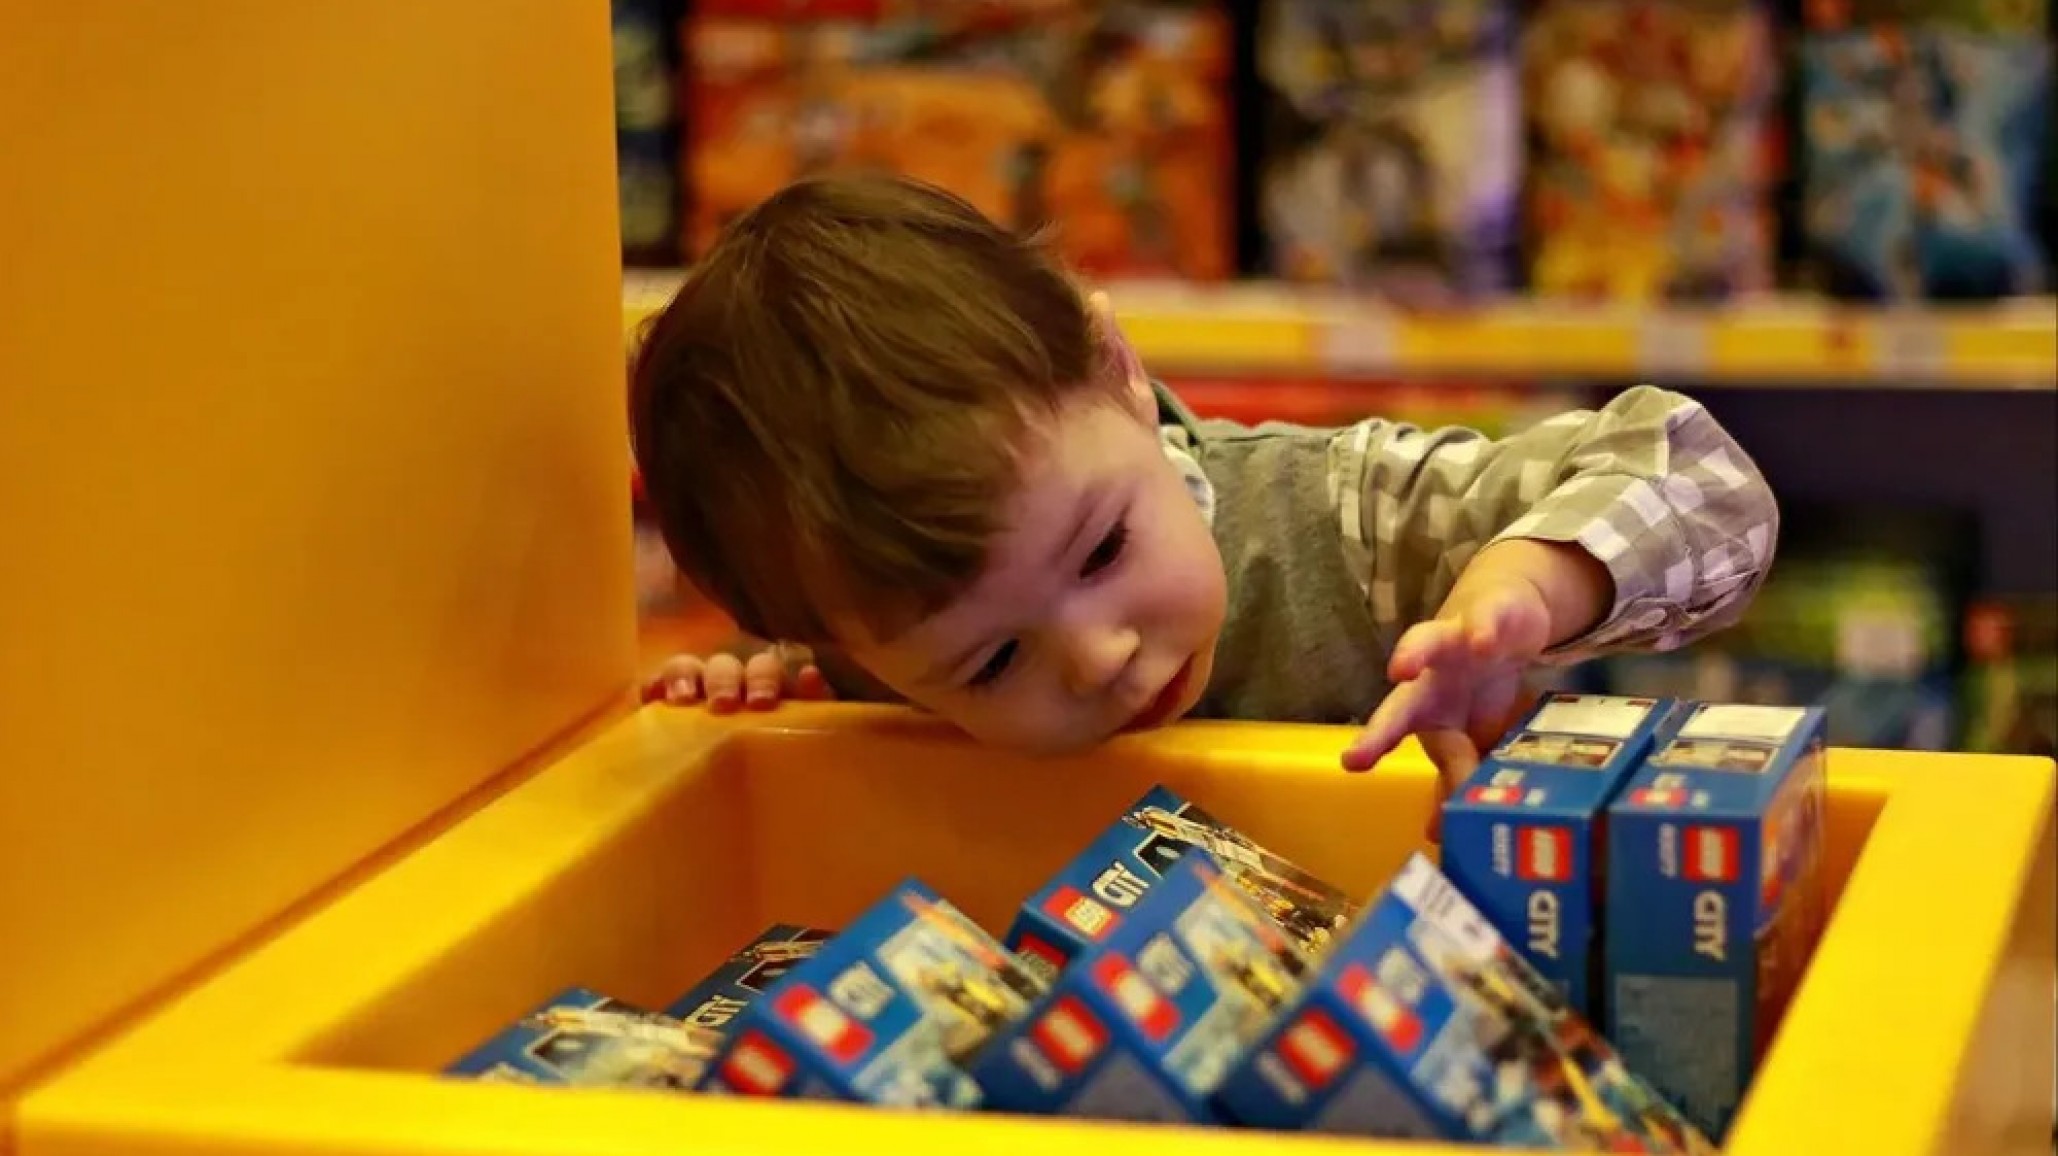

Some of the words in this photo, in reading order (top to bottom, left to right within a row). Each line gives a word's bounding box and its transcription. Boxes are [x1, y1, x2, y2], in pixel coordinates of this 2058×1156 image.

[1092, 861, 1149, 907] CITY
[1528, 889, 1559, 959] CITY
[1694, 889, 1726, 961] CITY
